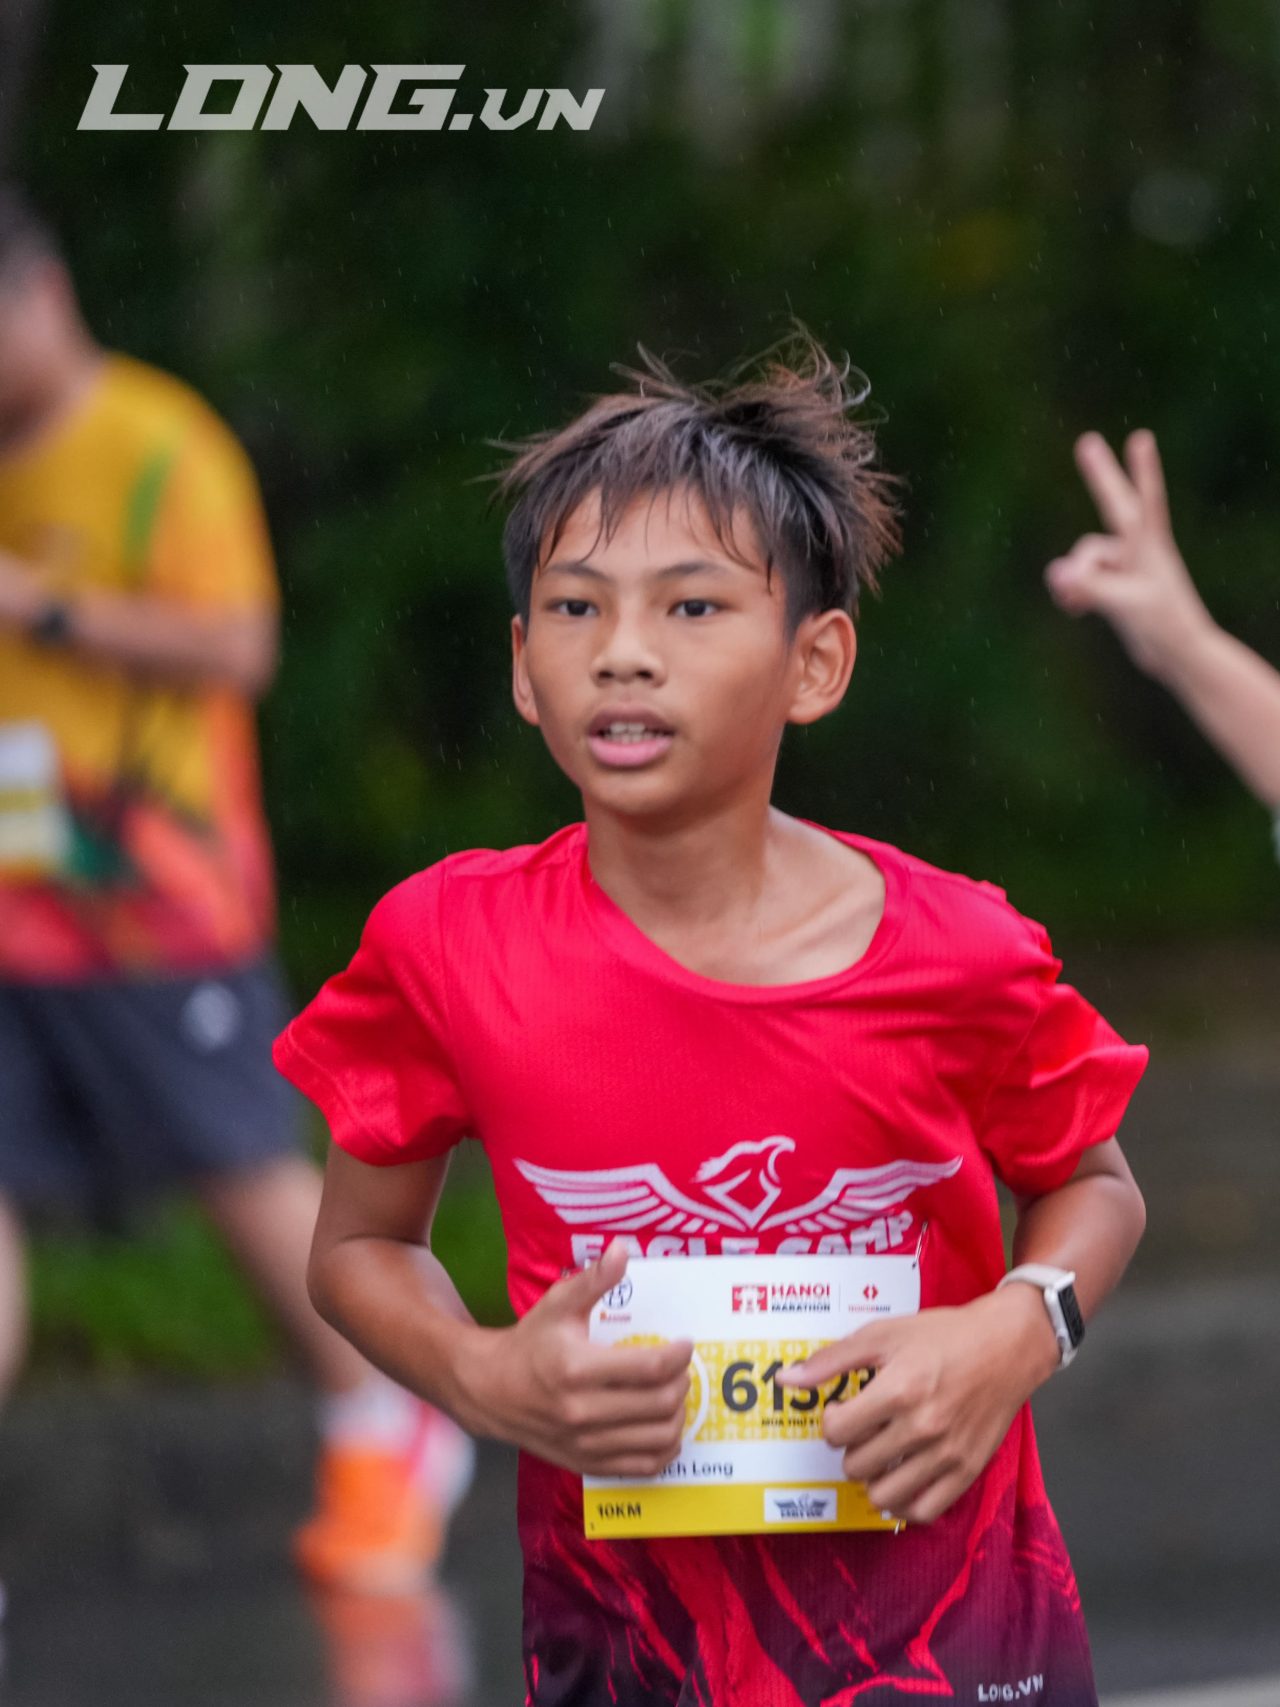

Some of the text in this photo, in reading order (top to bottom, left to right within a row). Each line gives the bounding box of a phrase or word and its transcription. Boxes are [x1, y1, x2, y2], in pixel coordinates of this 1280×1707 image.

[771, 1284, 830, 1297] HANOI
[771, 1303, 831, 1313] MARATHON
[692, 1460, 734, 1476] Long
[596, 1502, 643, 1519] 10KM
